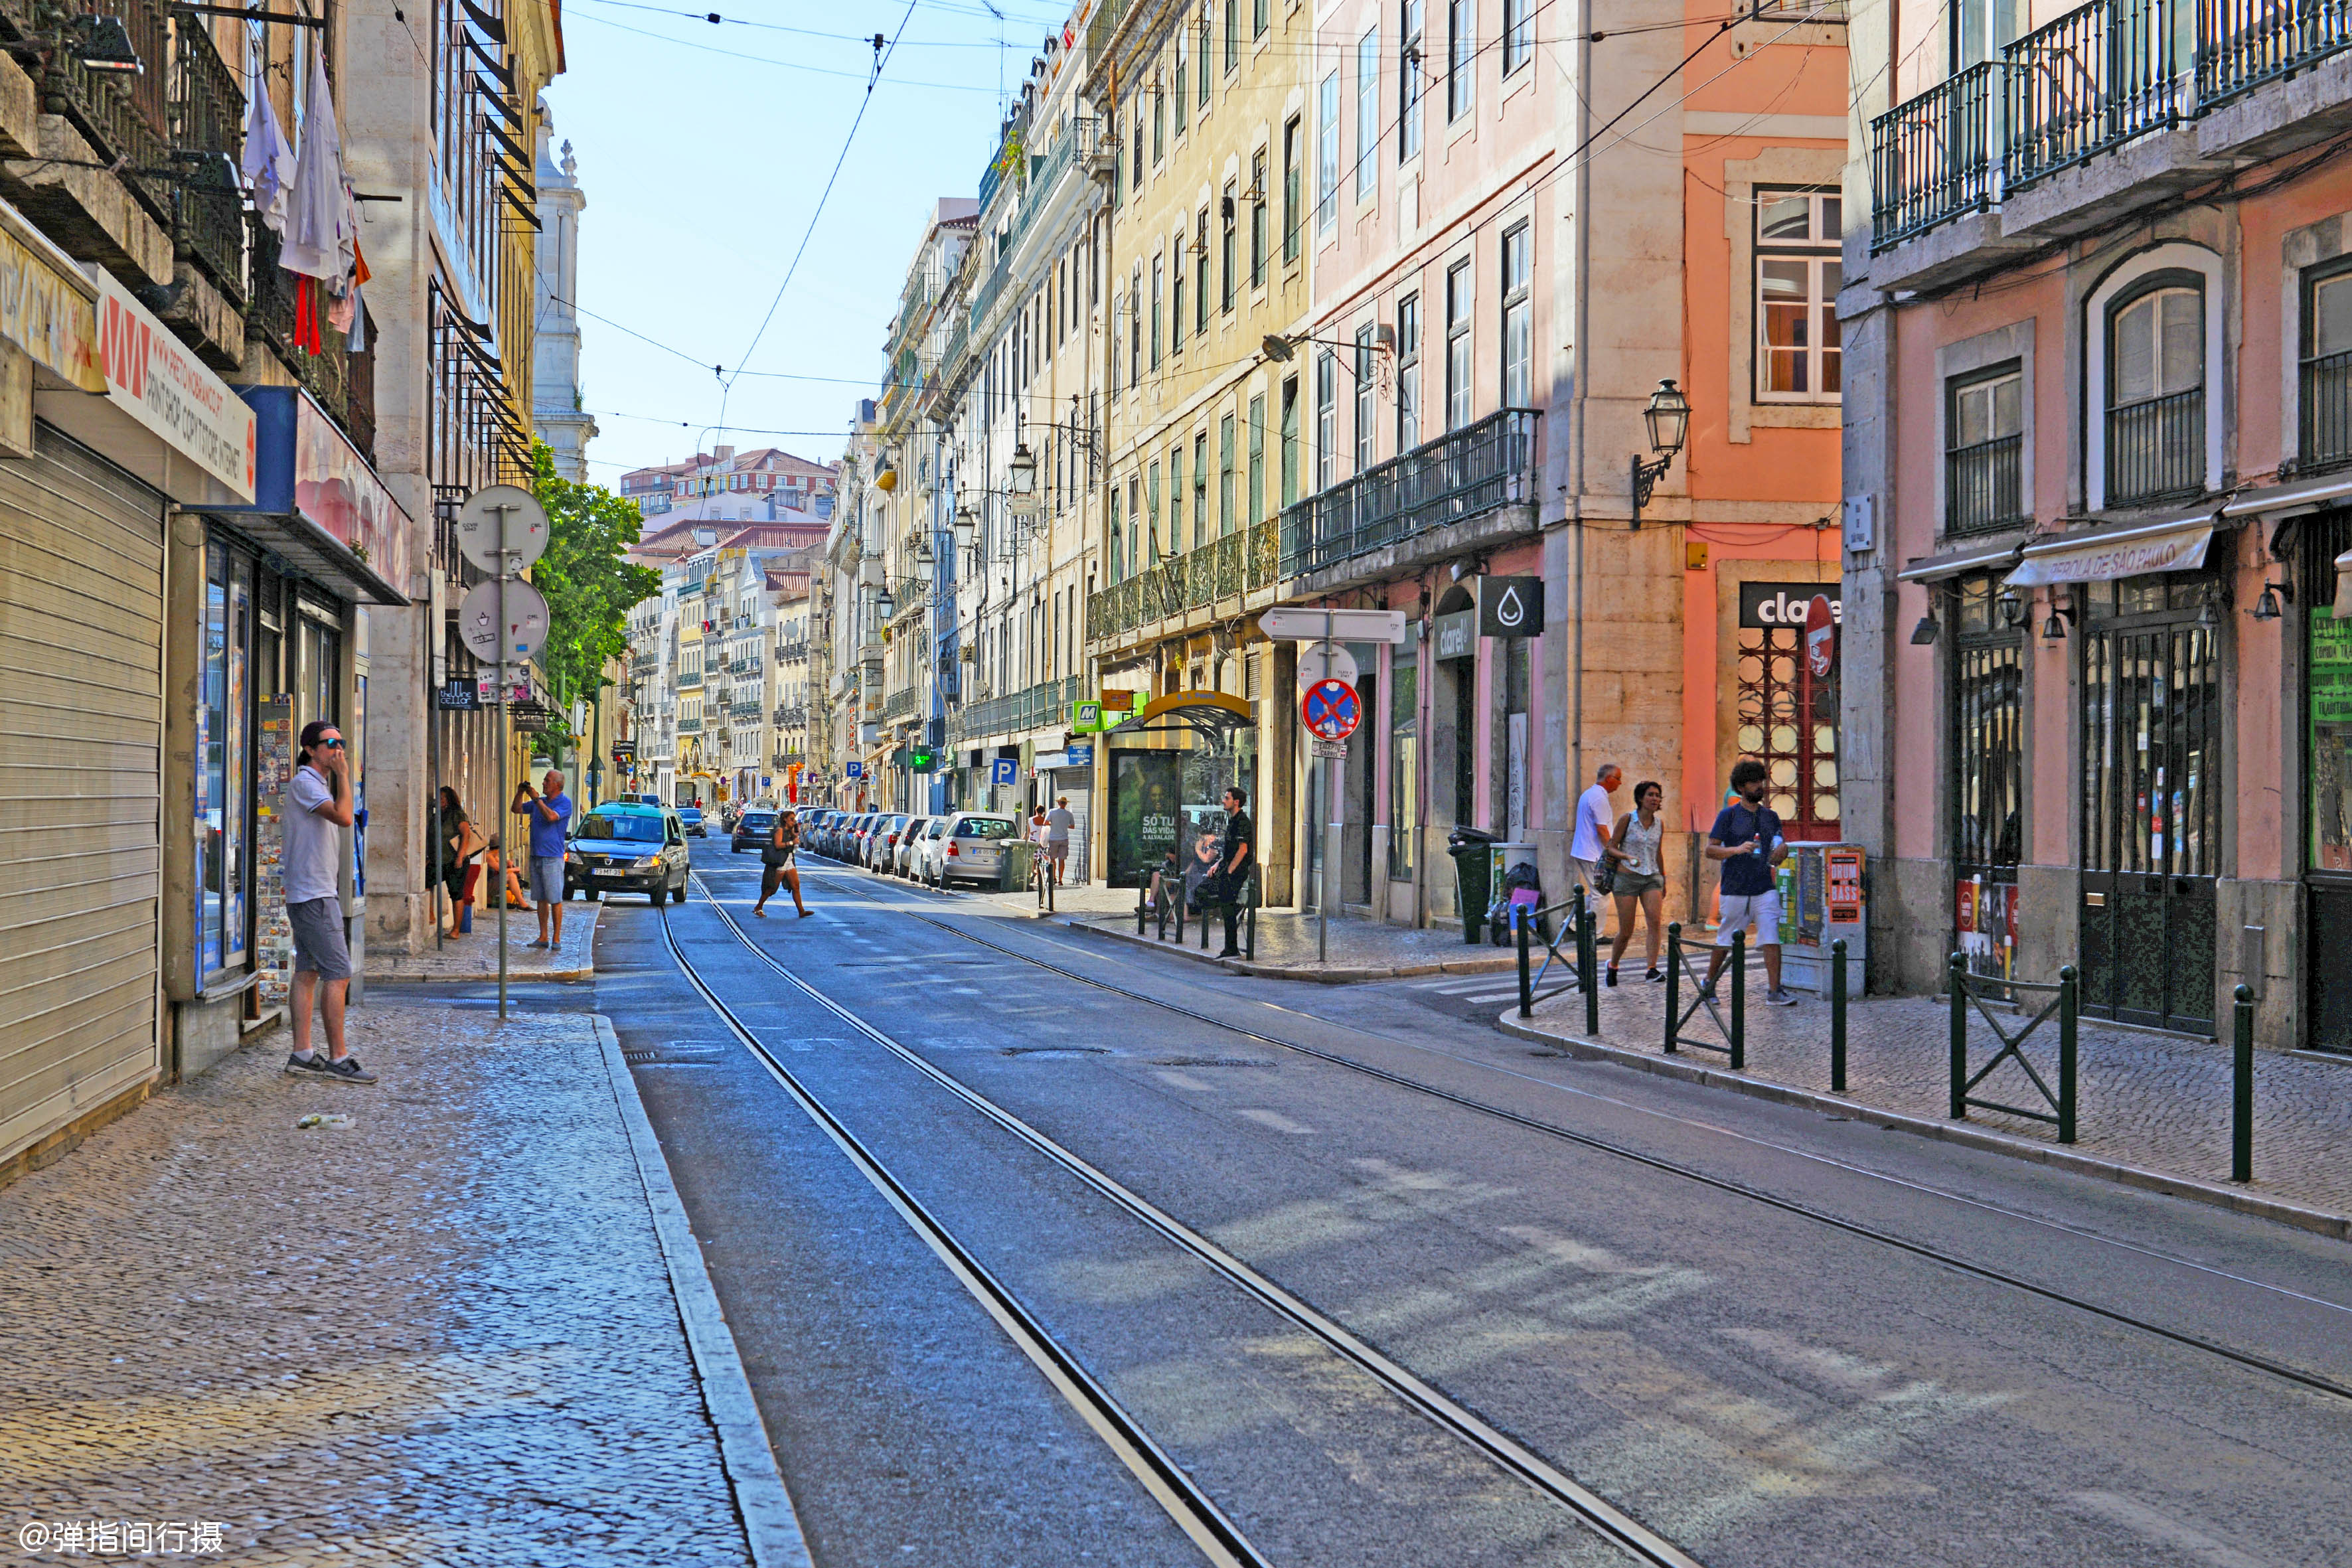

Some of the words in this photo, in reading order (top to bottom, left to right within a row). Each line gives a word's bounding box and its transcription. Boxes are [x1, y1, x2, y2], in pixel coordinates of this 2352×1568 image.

[2093, 553, 2111, 575] DE
[2111, 546, 2135, 573] SÃO
[2137, 543, 2176, 570] PAULO
[1758, 591, 1842, 623] clae
[1441, 618, 1464, 656] clarel
[1319, 742, 1341, 751] EXCEPTO
[850, 764, 858, 775] P
[998, 762, 1012, 781] P
[1142, 813, 1158, 826] SÓ
[1161, 817, 1175, 826] TU
[1142, 824, 1157, 834] DÁS
[1832, 864, 1857, 879] DRUM
[1832, 886, 1857, 901] BASS
